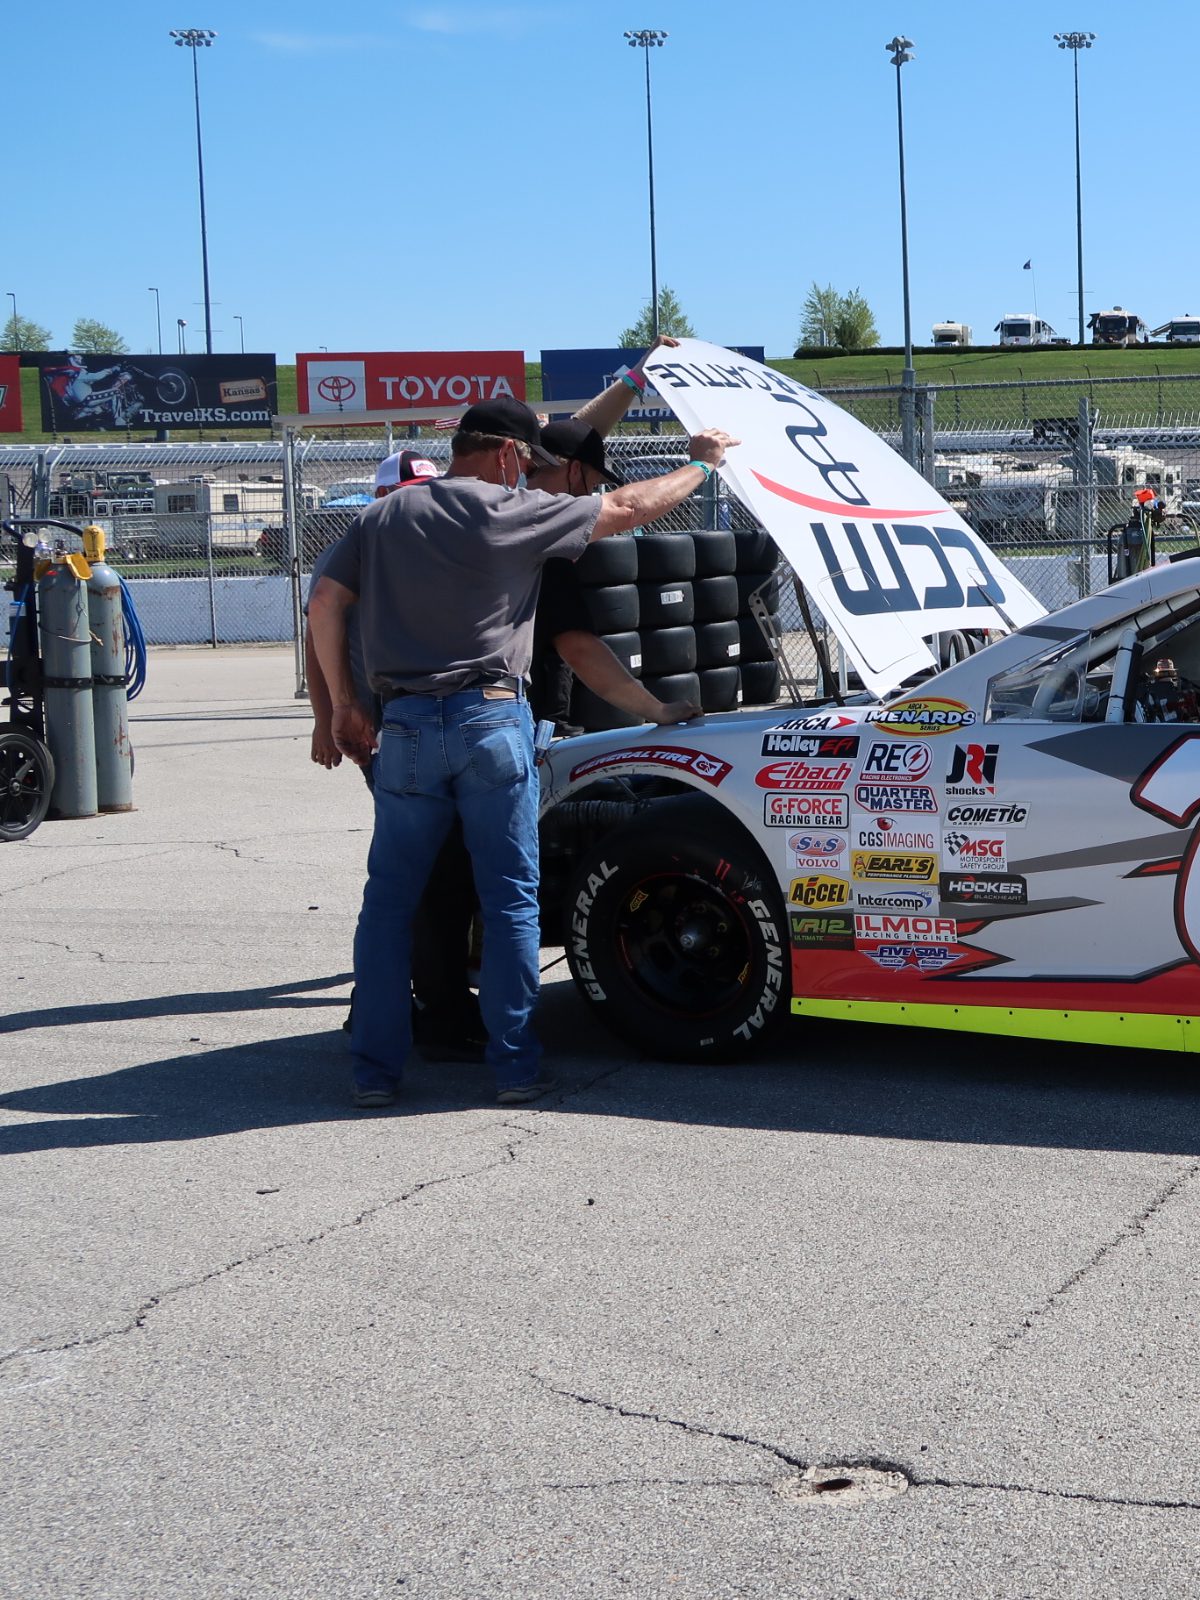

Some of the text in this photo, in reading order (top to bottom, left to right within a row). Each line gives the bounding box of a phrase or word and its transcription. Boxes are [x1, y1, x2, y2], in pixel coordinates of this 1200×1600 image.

[645, 363, 772, 391] CATTLE
[222, 387, 262, 398] Kansas
[379, 375, 514, 400] TOYOTA
[139, 407, 269, 423] TravelKS.com
[775, 716, 832, 731] ARCA
[866, 710, 977, 727] MENARDS
[767, 735, 820, 756] Holley
[575, 750, 650, 775] GENERAL
[652, 750, 692, 764] TIRE
[755, 762, 852, 790] Eibach
[858, 786, 929, 803] QUARTER
[945, 786, 985, 795] shocks
[771, 797, 842, 815] G-FORCE
[870, 799, 933, 811] MASTER
[771, 815, 842, 825] RACING GEAR
[948, 806, 1026, 822] COMETIC
[797, 837, 839, 852] S & S
[960, 840, 1005, 857] MSG
[798, 858, 839, 868] VOLVO
[868, 856, 930, 872] EARL'S
[949, 881, 1023, 893] HOOKER
[858, 893, 923, 911] Intercomp
[974, 893, 1022, 901] BLACKHEART
[572, 860, 619, 1000] GENERAL
[856, 915, 957, 934] ILMOR
[857, 932, 900, 940] RACING
[907, 934, 957, 942] ENGINES
[879, 946, 948, 958] FIVE STAR
[733, 899, 783, 1040] GENERAL
